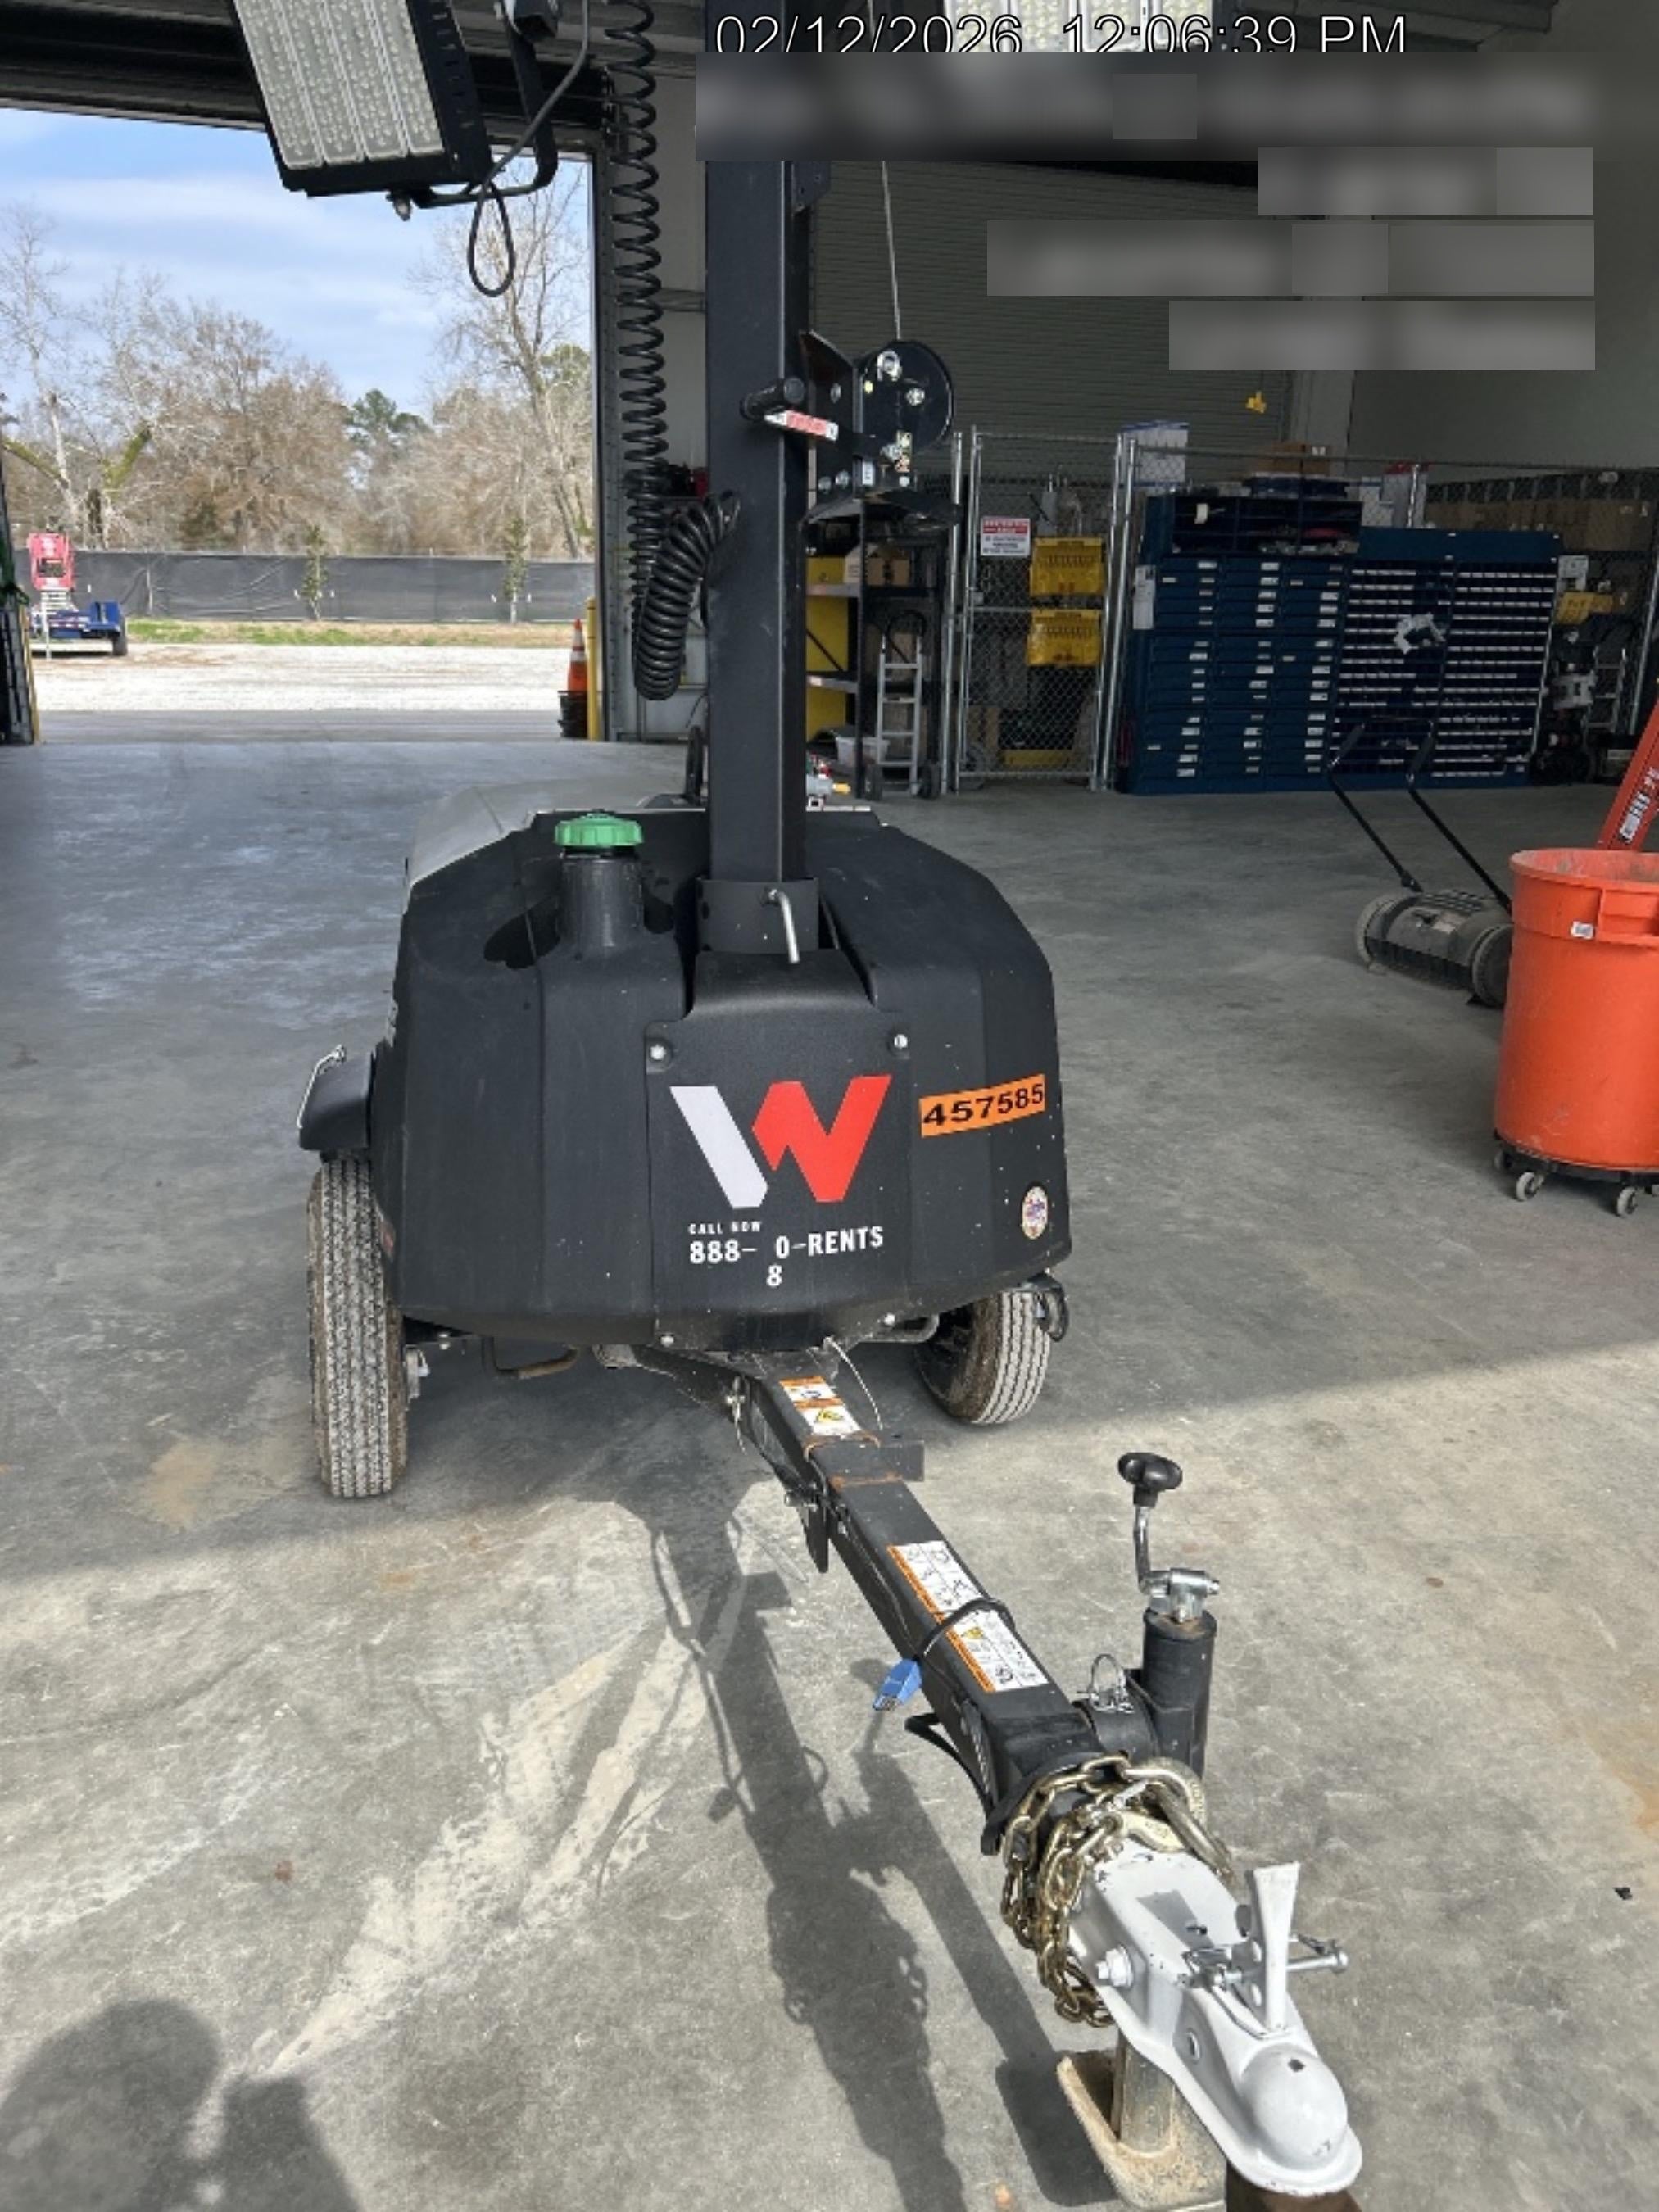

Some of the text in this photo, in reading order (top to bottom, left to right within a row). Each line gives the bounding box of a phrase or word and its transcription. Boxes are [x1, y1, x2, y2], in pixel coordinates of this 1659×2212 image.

[922, 1083, 1043, 1126] 457585
[688, 1221, 762, 1235] CALL NOW
[766, 1263, 783, 1287] 8
